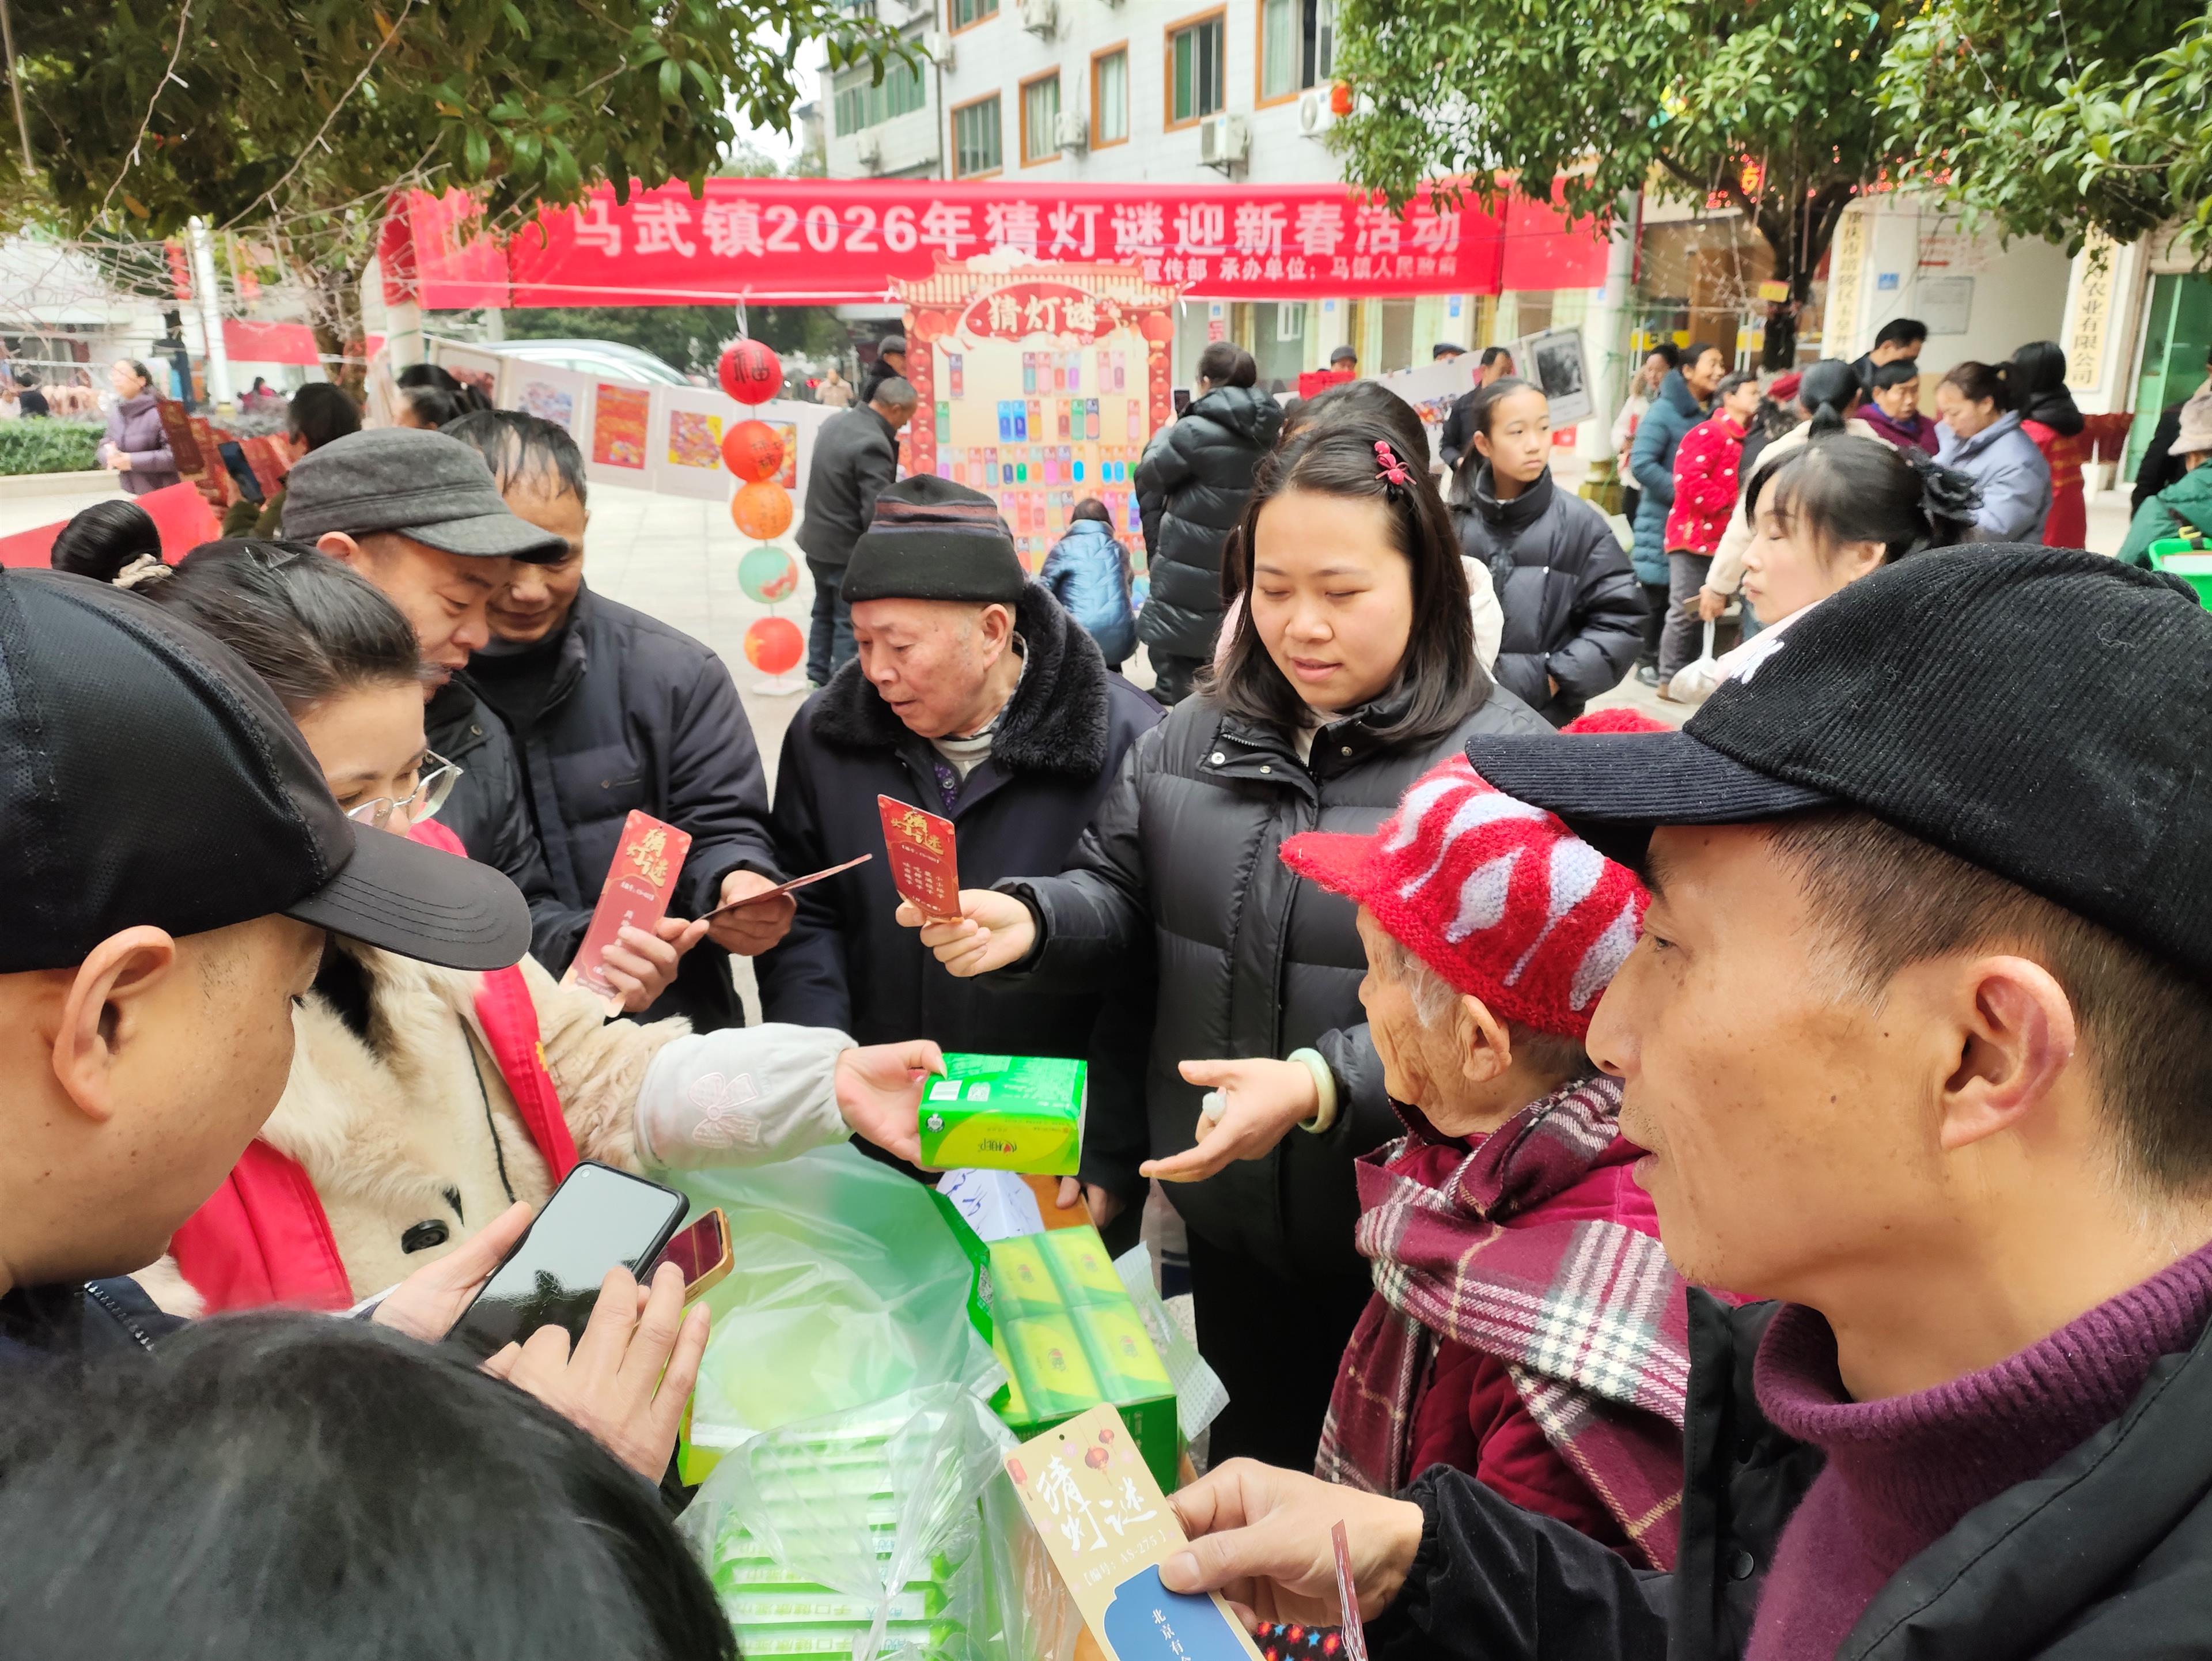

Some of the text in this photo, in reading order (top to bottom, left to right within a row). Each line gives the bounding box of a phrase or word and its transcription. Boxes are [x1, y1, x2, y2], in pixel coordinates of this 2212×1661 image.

[574, 198, 1460, 258] 马武镇2026年猜灯谜迎新春活动
[987, 293, 1097, 332] 猜灯谜
[733, 349, 770, 384] 福
[626, 828, 669, 888] 猜灯谜
[890, 809, 945, 856] 猜灯谜
[1035, 1453, 1158, 1553] 猜灯谜
